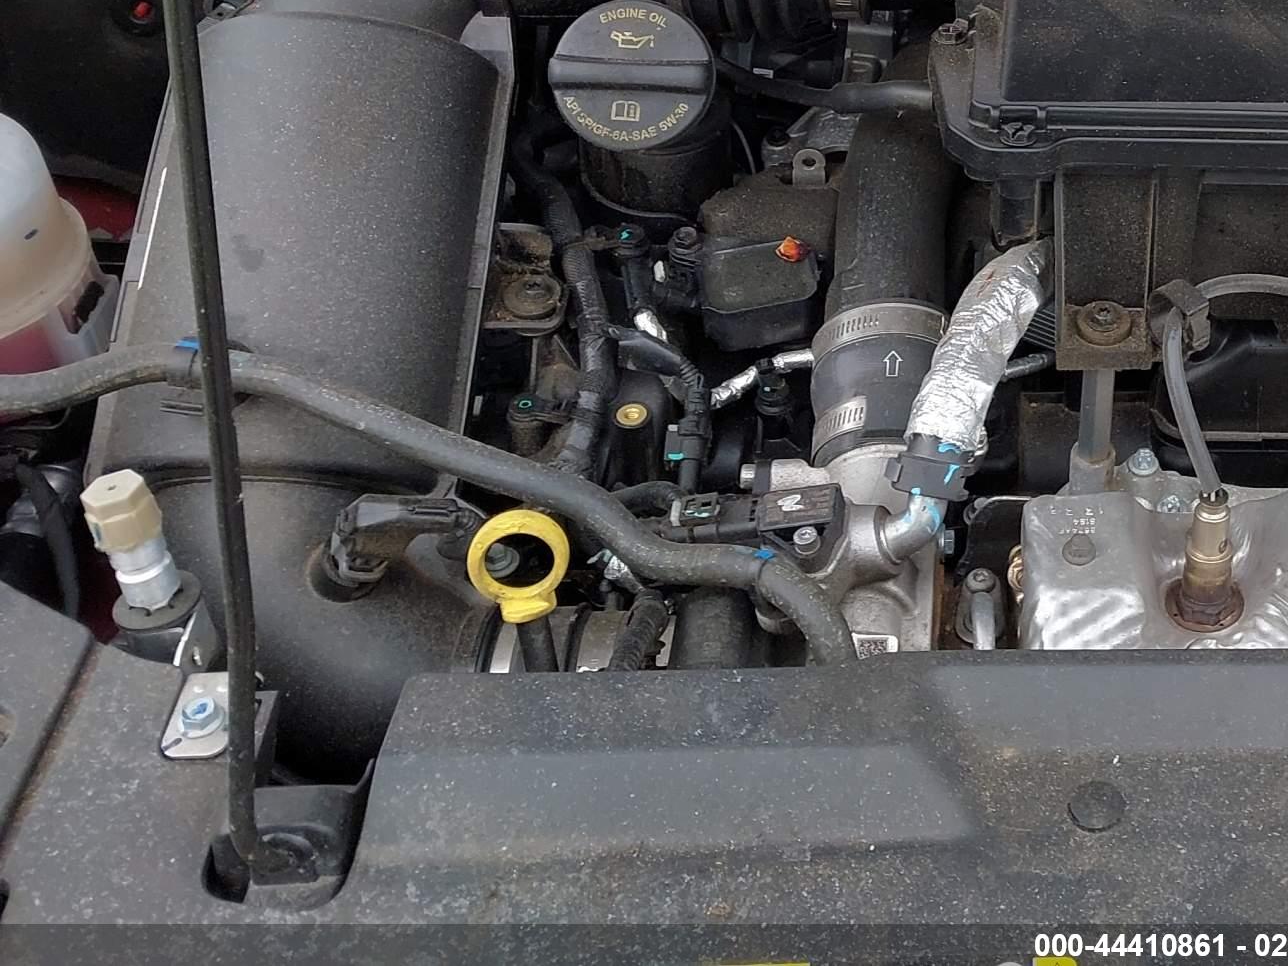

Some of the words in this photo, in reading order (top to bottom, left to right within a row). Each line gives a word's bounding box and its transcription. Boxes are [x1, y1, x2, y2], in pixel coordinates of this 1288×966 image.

[600, 8, 647, 23] ENGINE
[649, 11, 668, 28] OIL
[563, 95, 580, 114] API
[658, 103, 689, 132] 5W-30
